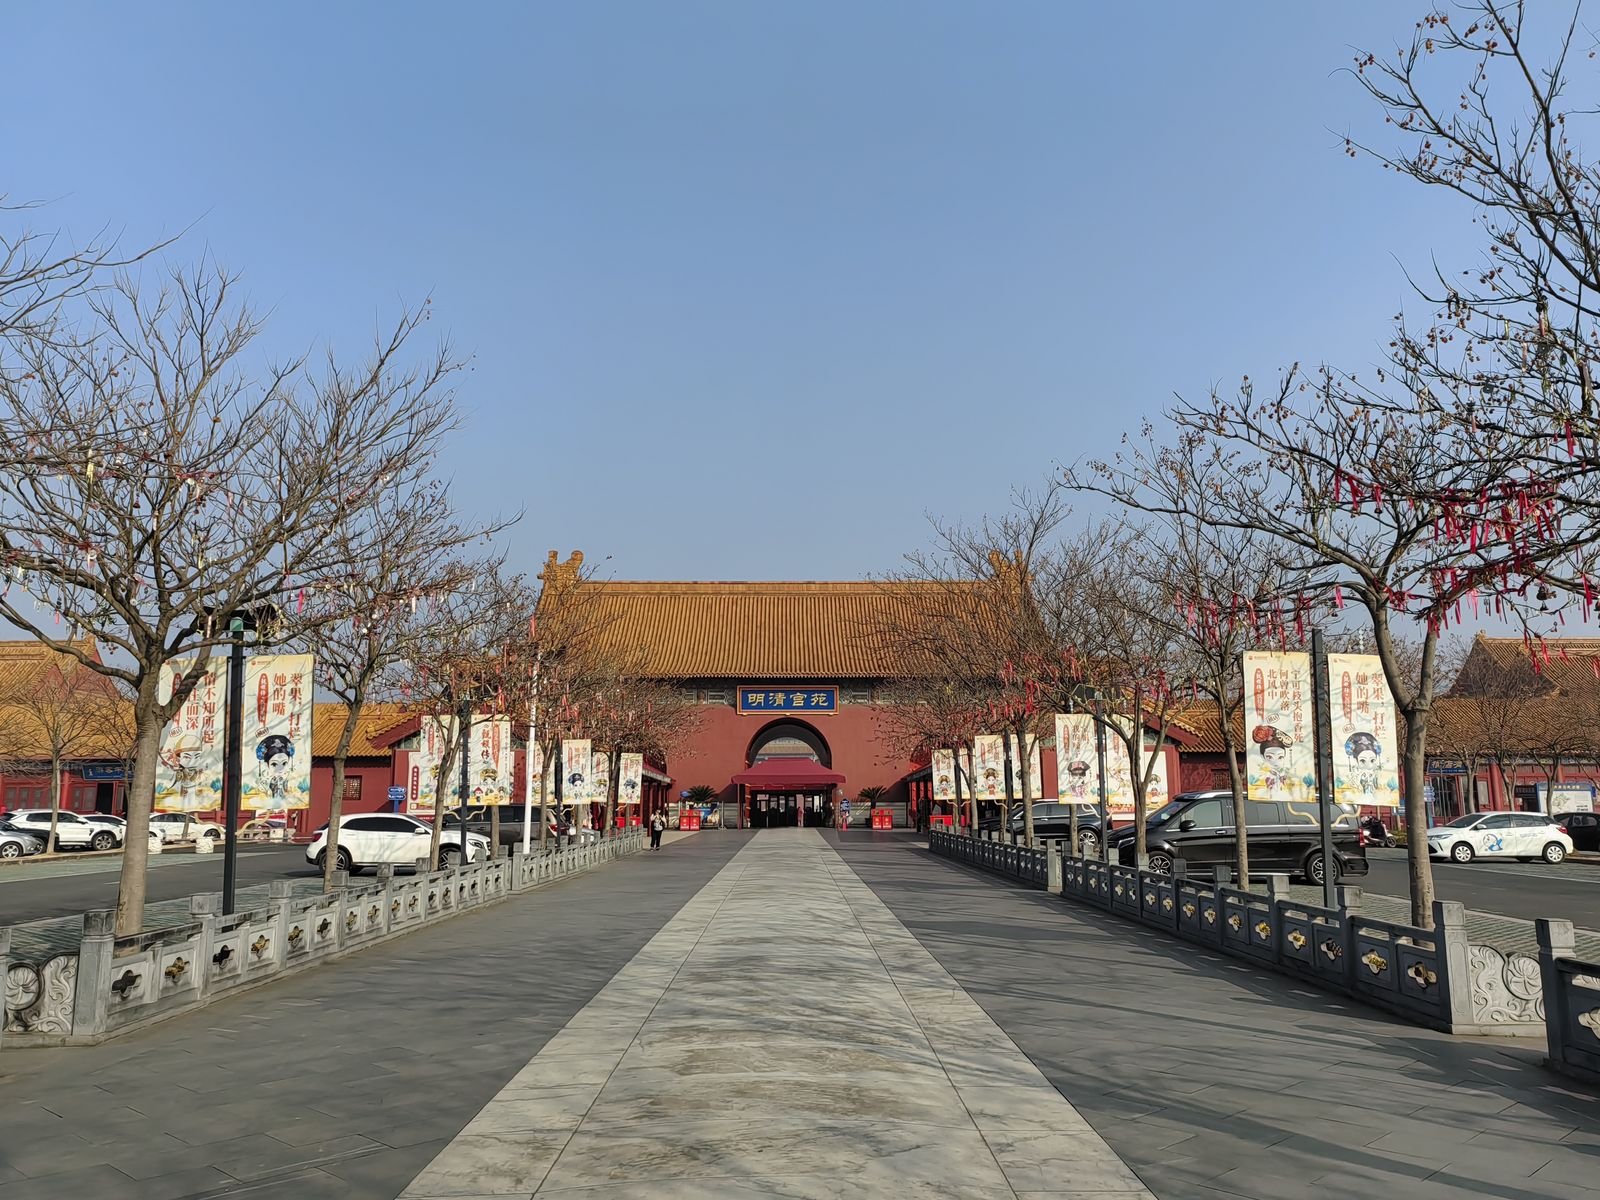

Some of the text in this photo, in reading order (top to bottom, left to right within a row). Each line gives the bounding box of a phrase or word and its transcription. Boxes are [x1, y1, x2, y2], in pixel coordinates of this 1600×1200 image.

[272, 673, 286, 715] 她的嘴
[747, 692, 829, 707] 明清宫苑
[1267, 670, 1277, 700] 北风中
[1356, 672, 1370, 713] 她的嘴
